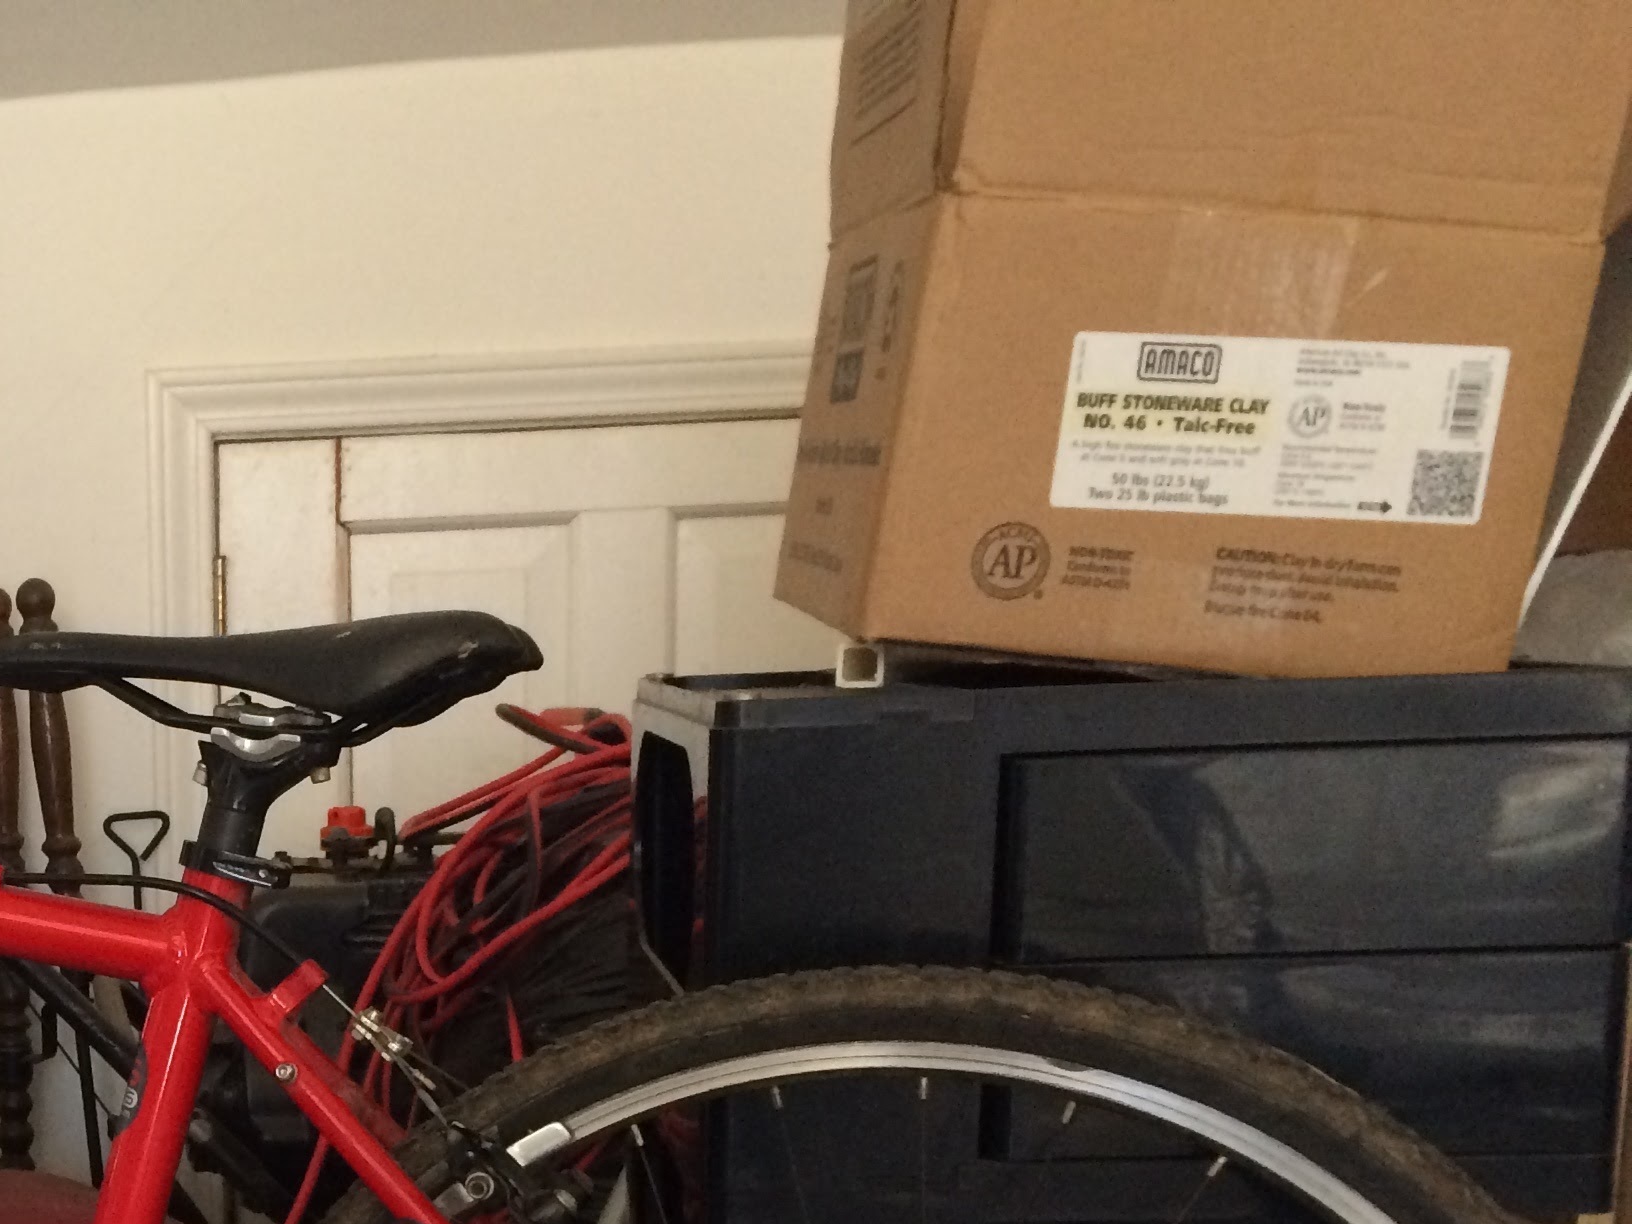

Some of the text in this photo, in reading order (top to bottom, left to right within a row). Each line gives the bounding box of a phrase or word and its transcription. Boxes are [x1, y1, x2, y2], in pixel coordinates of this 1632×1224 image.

[1144, 347, 1216, 377] AMACO
[1077, 392, 1270, 415] BUFF STONEWARE CLAY
[1083, 413, 1256, 434] NO. 46 Talc-Free
[1113, 472, 1127, 485] 50
[1131, 472, 1149, 486] lbs
[1089, 486, 1228, 507] Two 25 lb plastic bags
[987, 544, 1038, 579] AP
